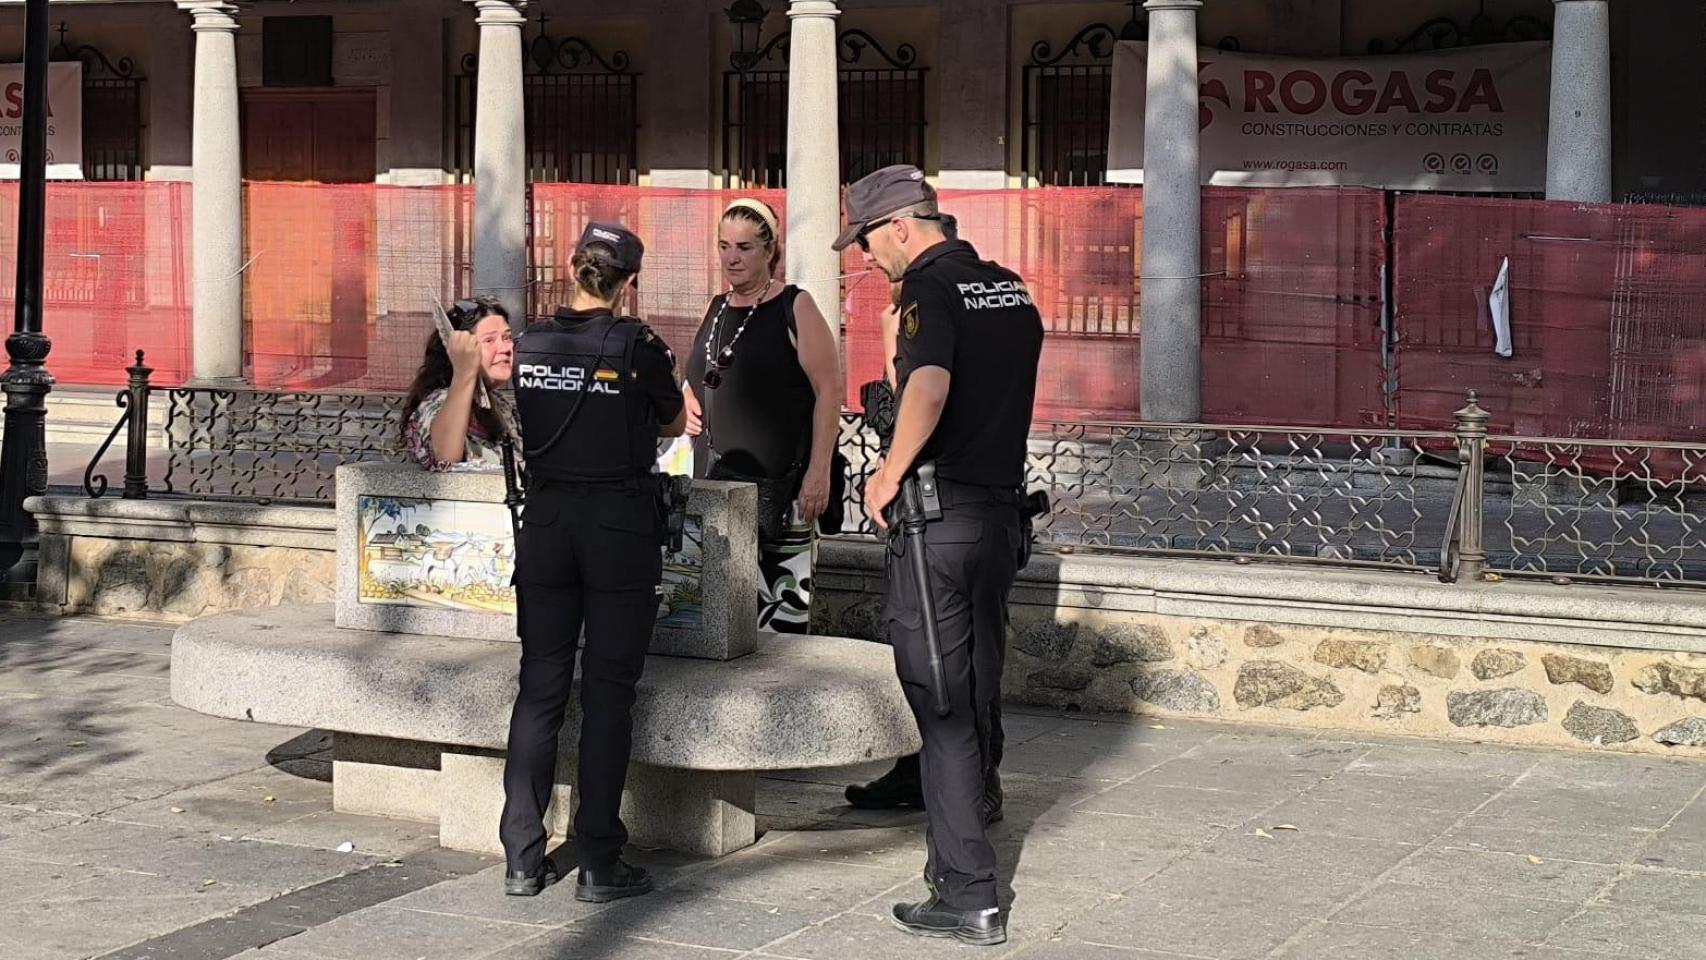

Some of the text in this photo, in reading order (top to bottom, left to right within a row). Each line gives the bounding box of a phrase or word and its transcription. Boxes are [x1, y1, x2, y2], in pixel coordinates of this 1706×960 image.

[1243, 69, 1504, 115] ROGASA
[1241, 122, 1504, 137] CONSTRUCCIONES Y CONTRATAS
[1242, 160, 1348, 171] www.rogasa.com
[963, 293, 1033, 310] NACION
[519, 364, 597, 380] POLICI
